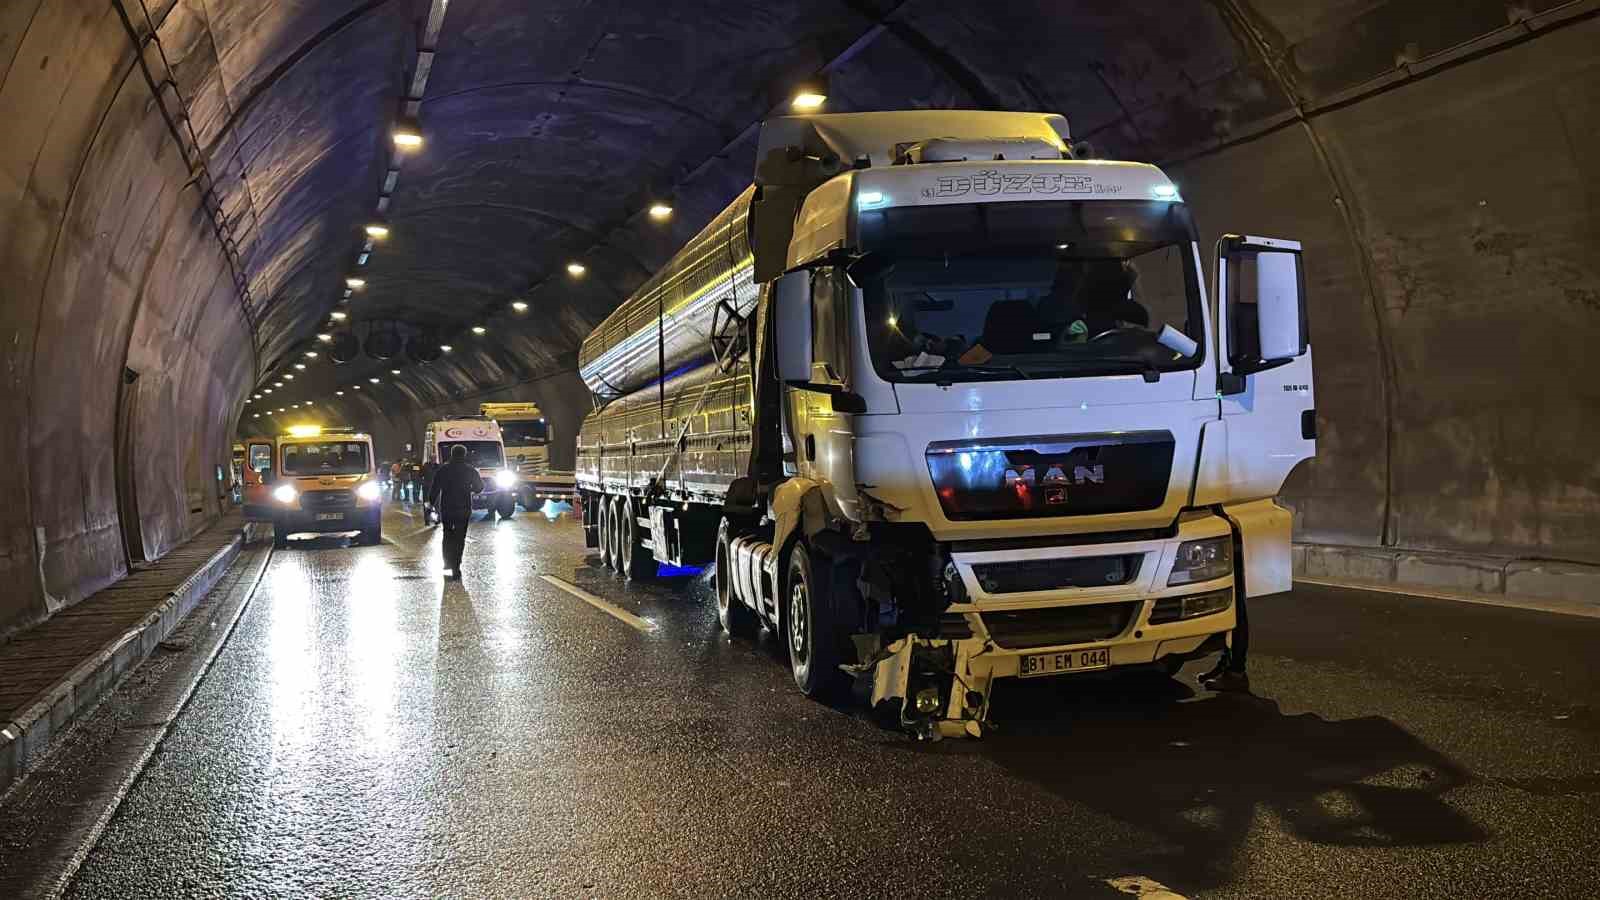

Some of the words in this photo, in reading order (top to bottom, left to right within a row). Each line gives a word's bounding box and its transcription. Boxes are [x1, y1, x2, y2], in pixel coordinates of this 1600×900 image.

[1005, 464, 1105, 487] MAN
[1029, 656, 1045, 672] 81
[1056, 653, 1073, 670] EM
[1081, 650, 1106, 667] 044
